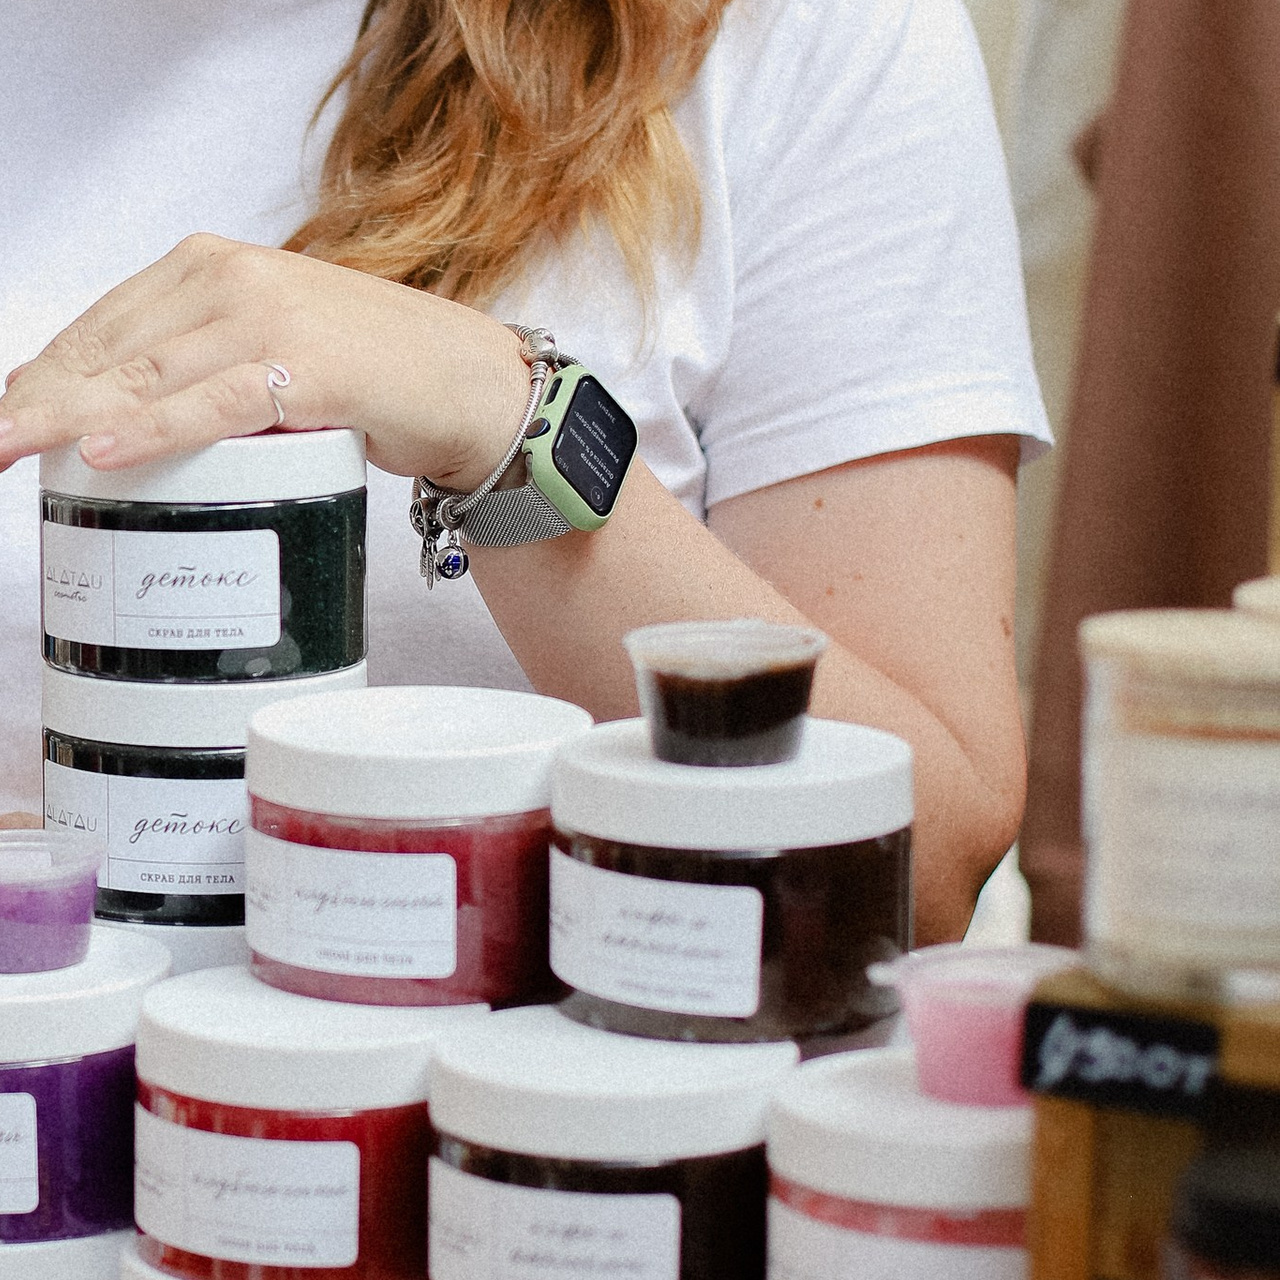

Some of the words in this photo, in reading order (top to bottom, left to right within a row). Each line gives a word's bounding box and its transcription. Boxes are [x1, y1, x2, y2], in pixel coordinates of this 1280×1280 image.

[136, 566, 260, 600] детокс
[148, 628, 183, 639] СКРАБ
[186, 628, 211, 639] ДЛЯ
[215, 627, 244, 638] ТЕЛА
[129, 812, 245, 844] детокс
[140, 872, 175, 883] СКРАБ
[178, 874, 202, 885] ДЛЯ
[206, 875, 236, 885] ТЕЛА
